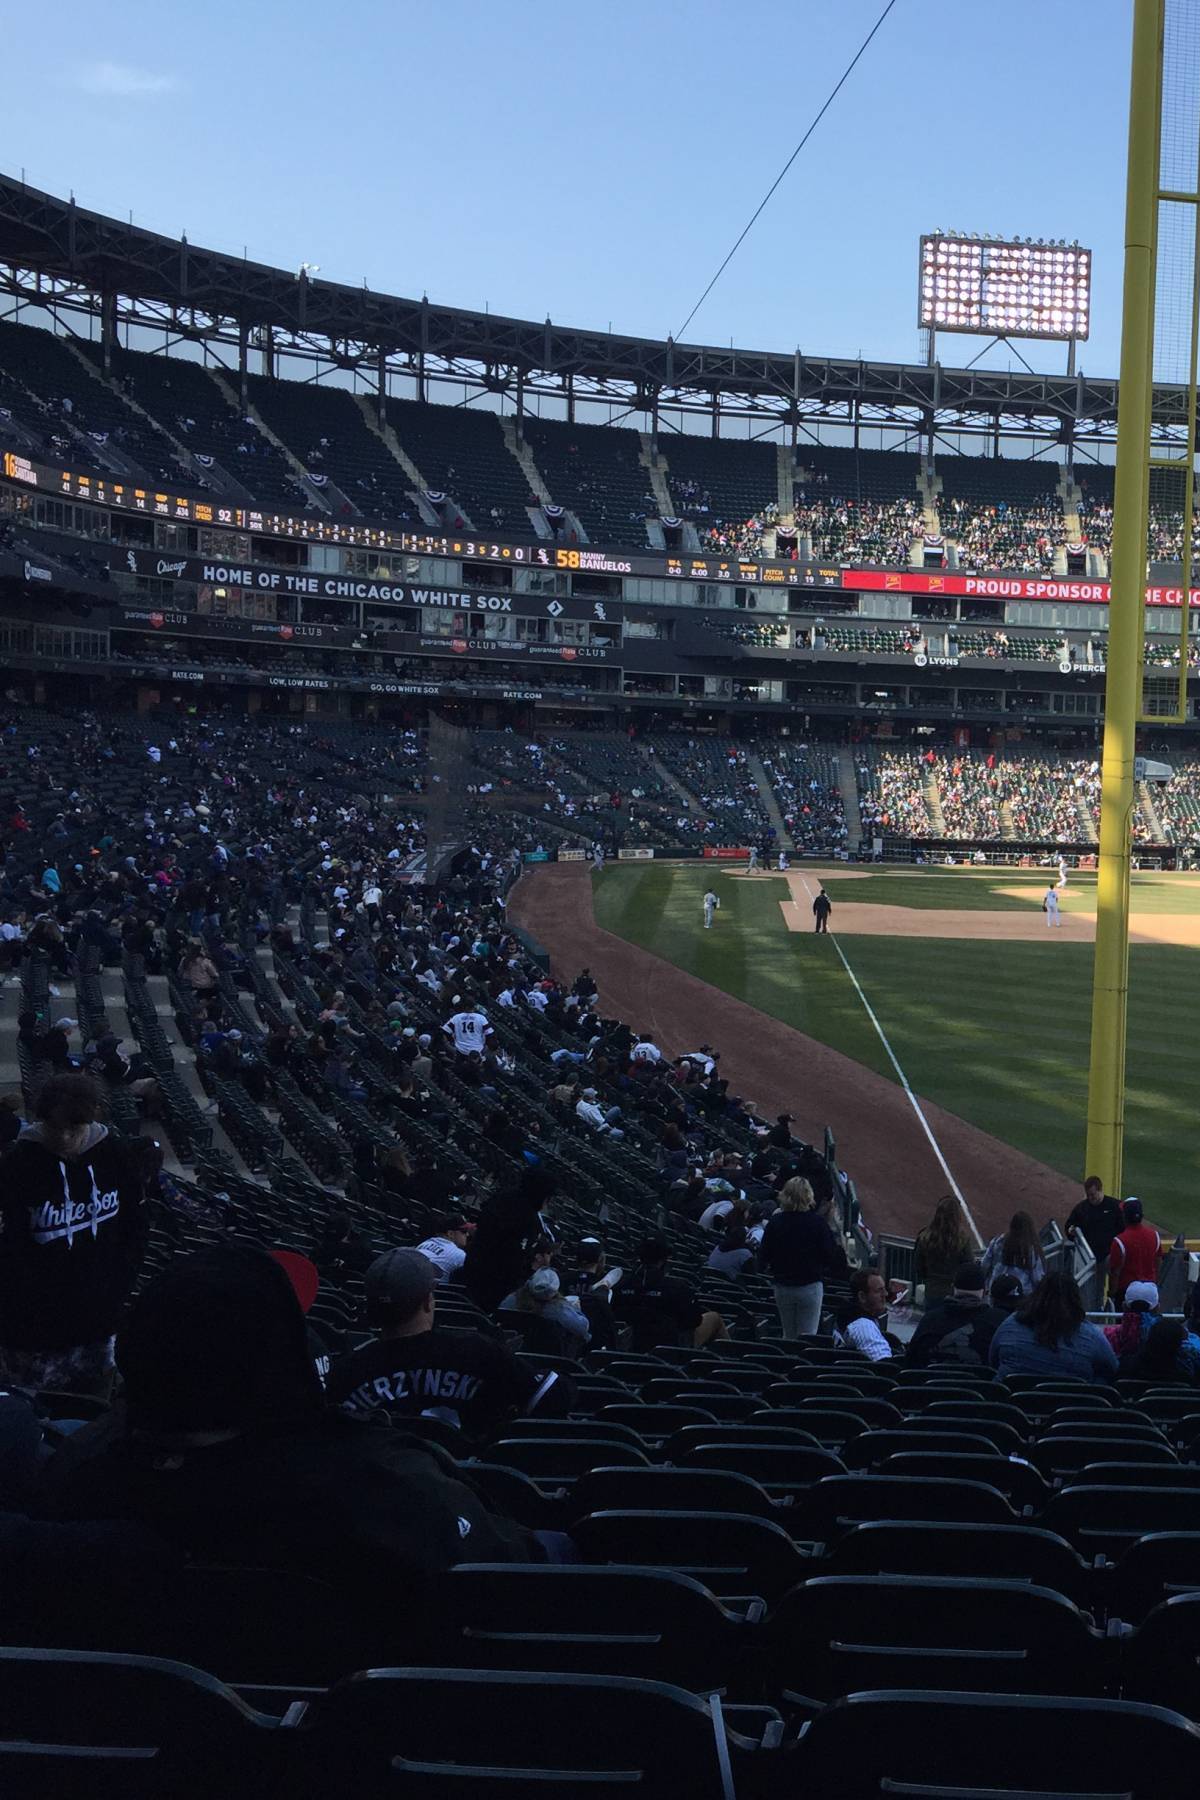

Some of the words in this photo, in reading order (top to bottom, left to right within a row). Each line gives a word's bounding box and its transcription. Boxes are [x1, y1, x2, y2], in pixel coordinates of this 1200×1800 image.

[4, 452, 15, 477] 16
[136, 500, 145, 508] 14
[218, 510, 231, 522] 92
[467, 543, 475, 554] 3
[479, 546, 486, 554] S
[491, 545, 499, 557] 2
[515, 548, 523, 560] 0
[557, 550, 579, 568] 58
[157, 560, 187, 577] Chicago
[580, 559, 631, 572] BANUELOS
[763, 574, 785, 582] COUNT
[819, 569, 839, 577] TOTAL
[203, 566, 252, 585] HOME
[258, 573, 280, 588] OF
[285, 576, 318, 592] THE
[325, 580, 404, 601] CHICAGO
[411, 589, 471, 607] WHITE
[477, 596, 512, 611] SOX
[966, 580, 1020, 596] PROUD
[1026, 582, 1102, 599] SPONSOR
[164, 614, 188, 624] CLUB
[295, 628, 322, 636] CLUB
[469, 640, 496, 649] CLUB
[578, 649, 606, 657] CLUB
[929, 657, 959, 666] LYONS
[1074, 664, 1105, 672] PIERCE
[173, 671, 204, 680] RATE.COM
[270, 678, 287, 687] LOW,
[288, 679, 303, 687] LOW
[305, 680, 328, 688] RATES
[371, 684, 384, 692] GO,
[398, 686, 422, 694] WHITE
[503, 691, 542, 700] RATE.COM
[462, 1022, 475, 1033] 14
[31, 1200, 85, 1228] White
[88, 1189, 119, 1215] Sox
